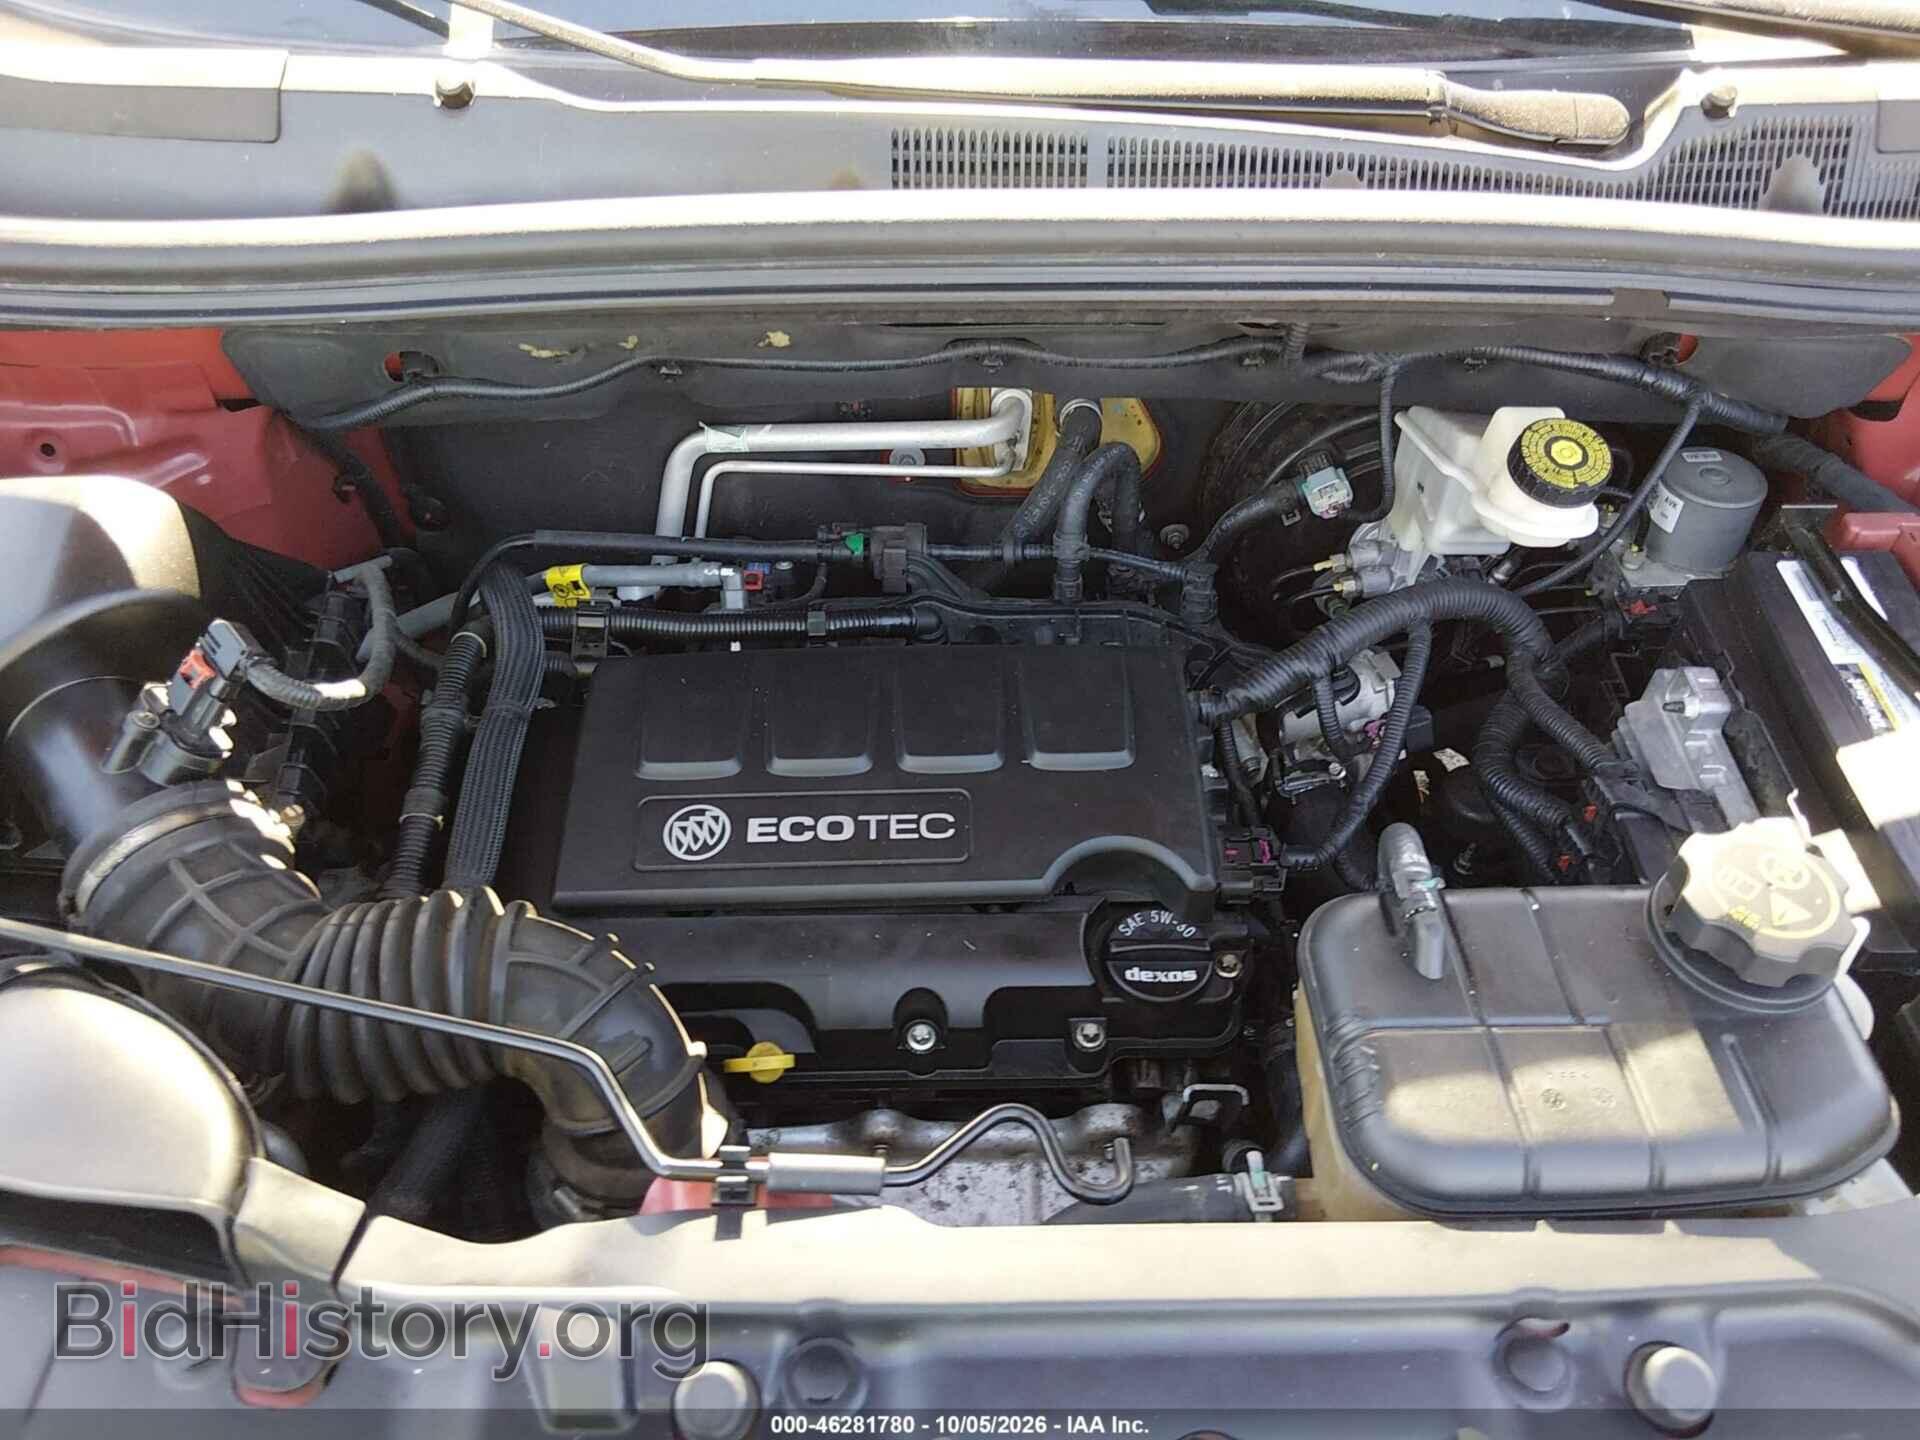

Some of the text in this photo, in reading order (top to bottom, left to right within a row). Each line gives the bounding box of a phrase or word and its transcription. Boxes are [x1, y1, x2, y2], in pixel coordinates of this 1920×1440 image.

[747, 813, 956, 843] ECOTEC
[1118, 912, 1146, 937] SAE
[1124, 966, 1198, 983] dexos
